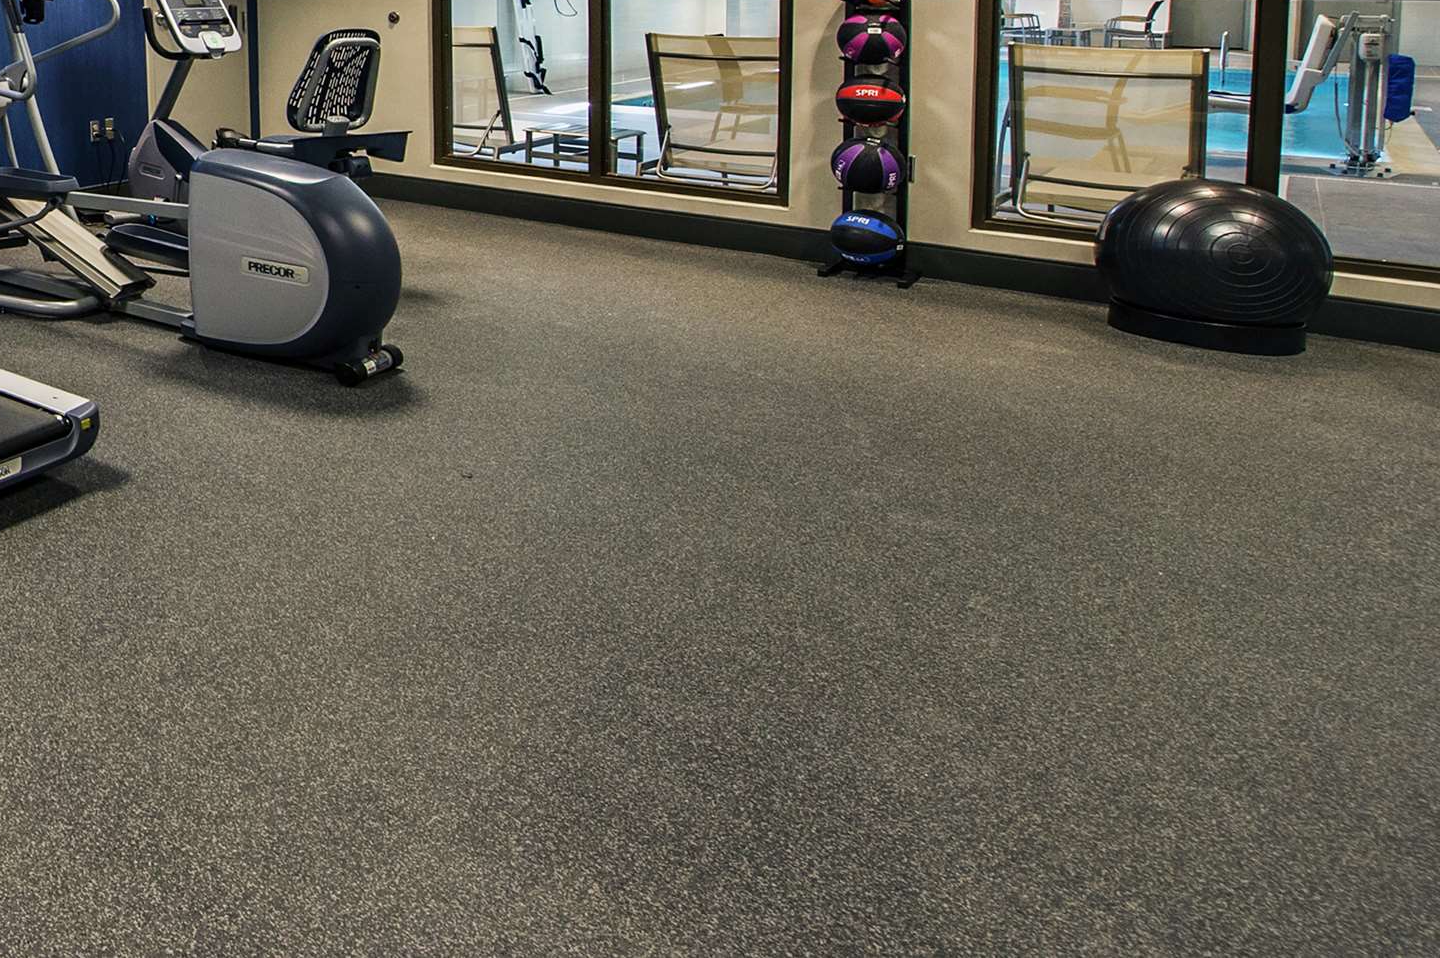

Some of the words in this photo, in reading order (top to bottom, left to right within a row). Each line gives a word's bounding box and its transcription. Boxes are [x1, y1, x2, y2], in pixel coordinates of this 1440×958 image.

[855, 88, 879, 97] SPRI
[846, 215, 870, 225] SPRI
[248, 261, 295, 279] PRECOR
